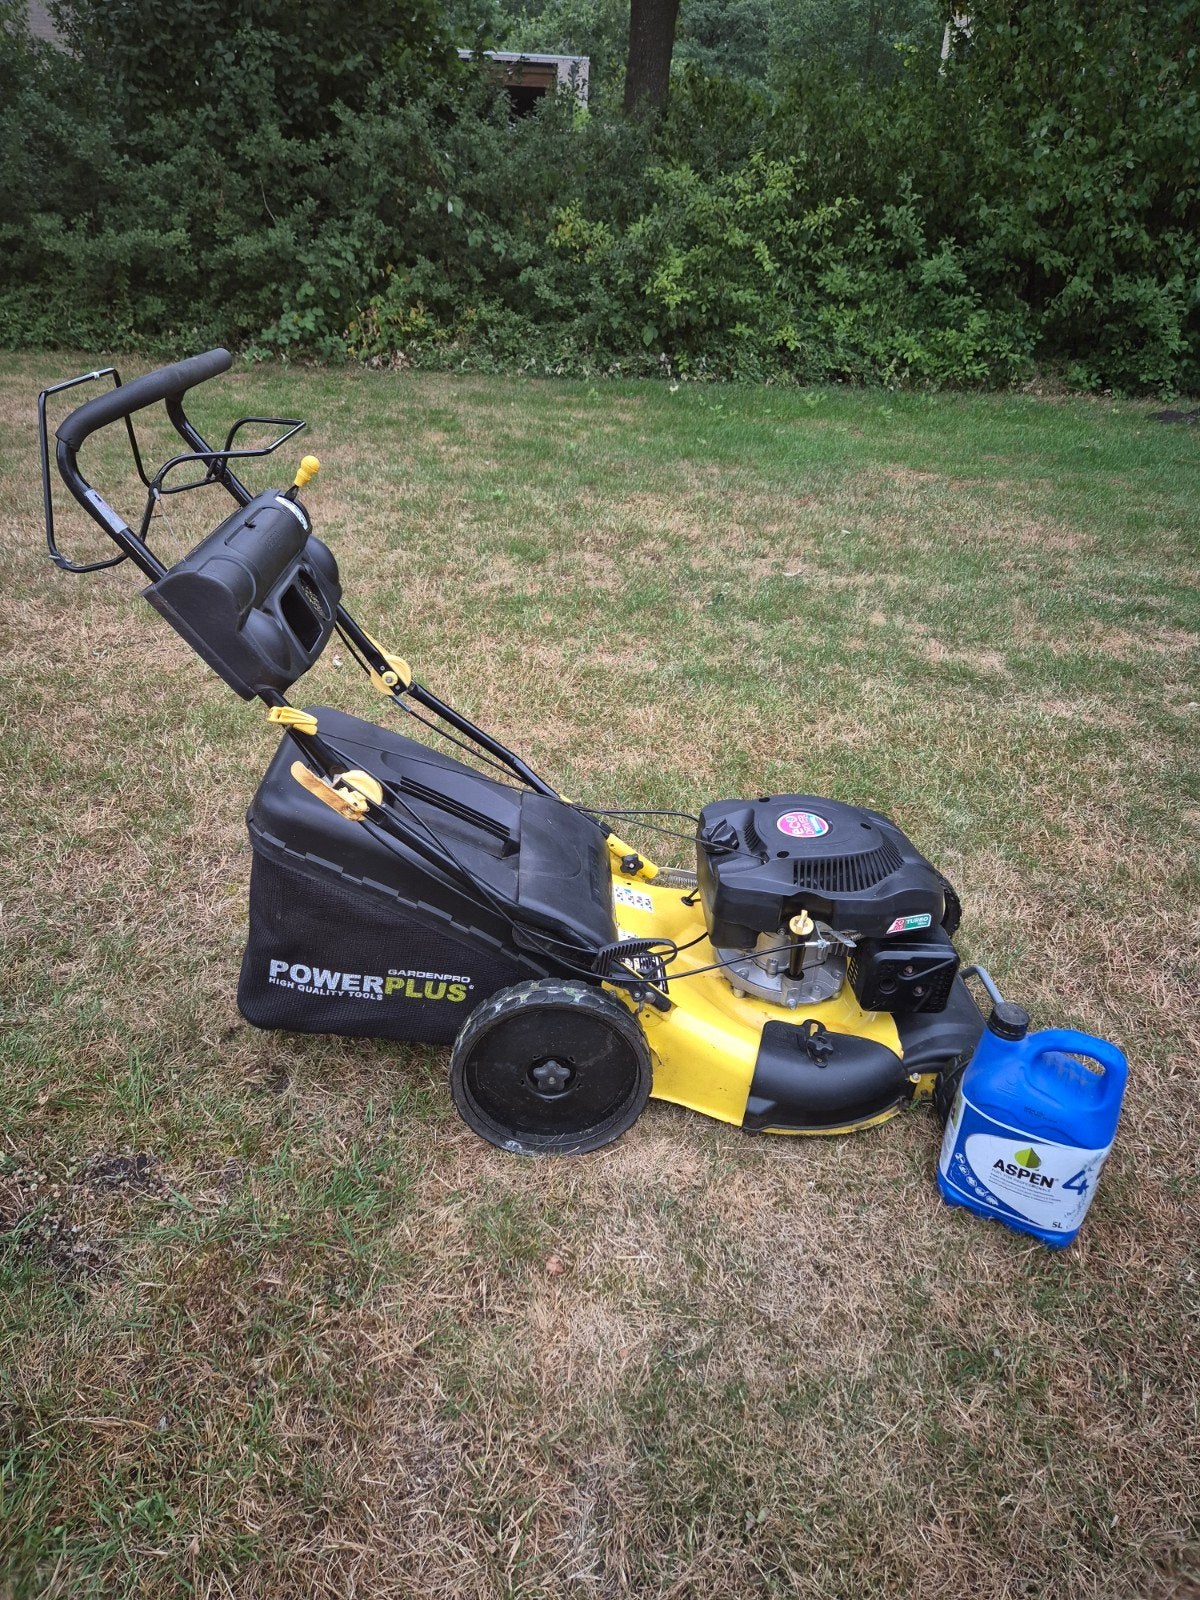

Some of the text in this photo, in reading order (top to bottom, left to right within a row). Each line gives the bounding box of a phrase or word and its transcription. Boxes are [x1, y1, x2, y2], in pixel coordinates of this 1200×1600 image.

[906, 916, 929, 924] TURBO
[388, 969, 470, 983] GARDENPRO
[268, 976, 383, 1001] HIGH QUALITY TOOLS
[993, 1159, 1055, 1189] ASPEN
[1062, 1169, 1089, 1195] 4
[1052, 1221, 1063, 1229] 5L
